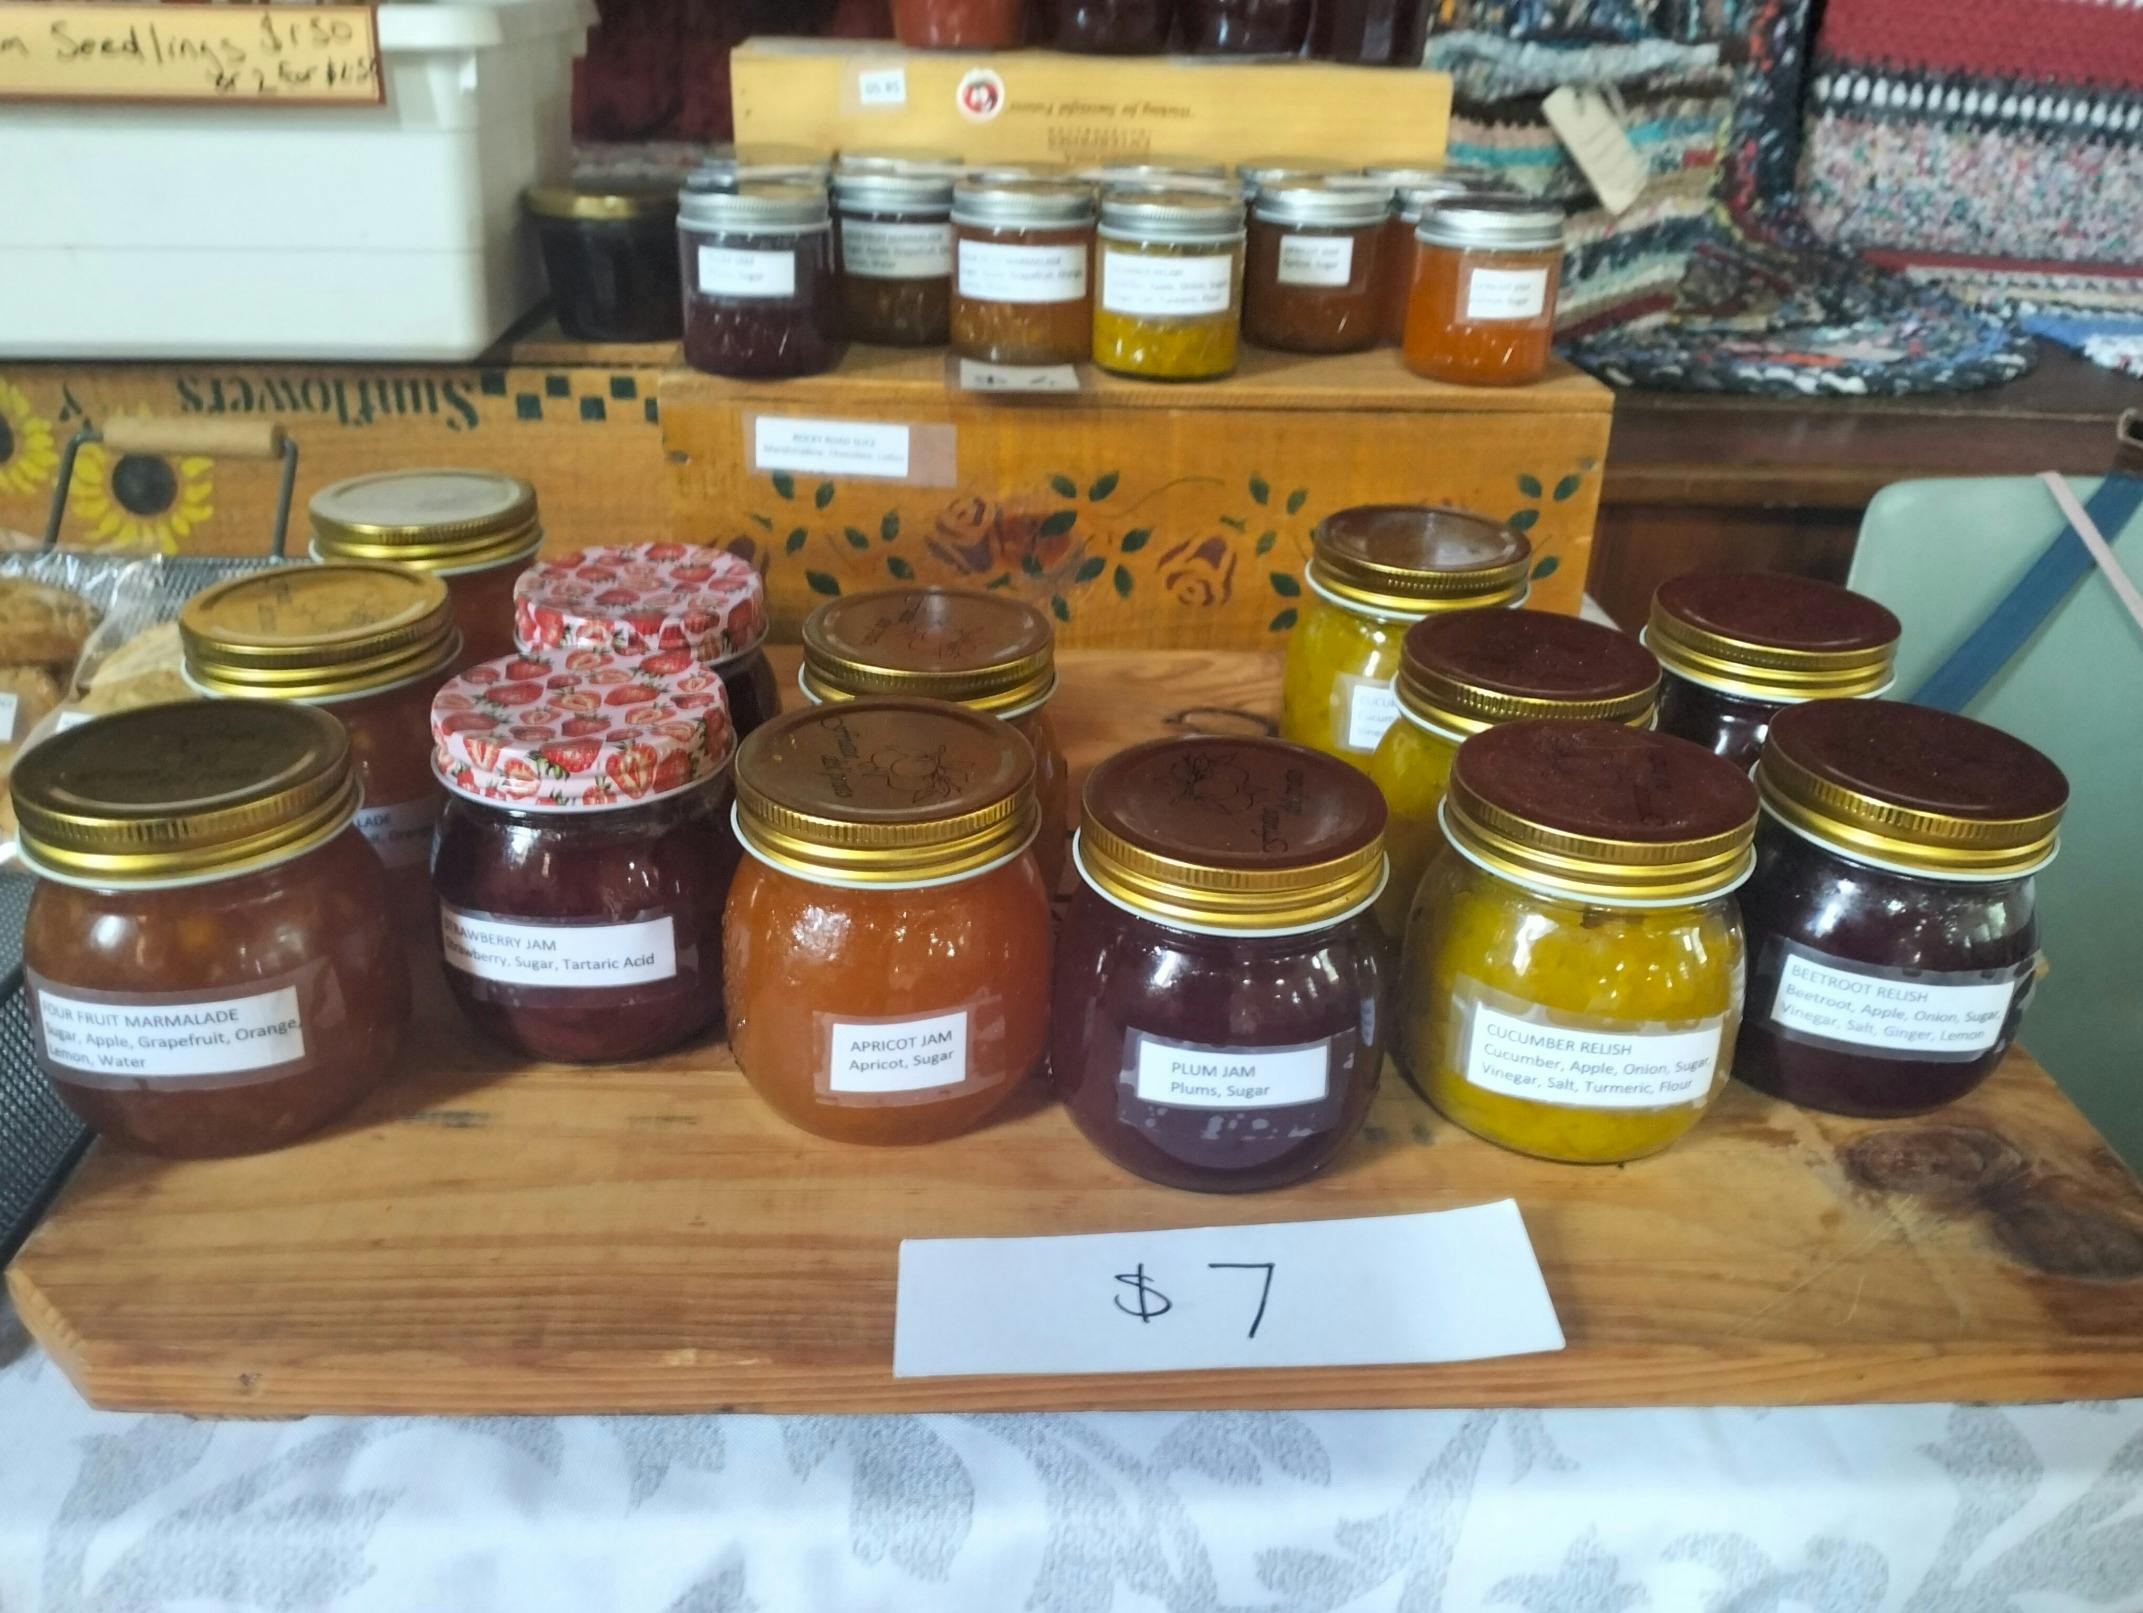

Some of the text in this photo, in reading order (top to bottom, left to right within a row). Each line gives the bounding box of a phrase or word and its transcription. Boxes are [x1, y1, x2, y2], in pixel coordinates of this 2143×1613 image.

[50, 20, 247, 72] Seedlings
[176, 375, 480, 432] Sunflowers
[525, 939, 557, 952] JAM
[514, 955, 559, 972] Sugar,
[563, 957, 619, 971] Tartaric
[623, 952, 655, 968] Acid
[1791, 964, 1929, 1003] BEETROOT RELISH
[1785, 983, 1856, 1013] Beetroot,
[1860, 1003, 1909, 1022] Apple,
[1914, 1009, 1961, 1024] Onion,
[77, 1010, 119, 1027] FRUIT
[124, 1008, 239, 1029] MARMALADE
[1780, 1002, 1985, 1043] Vinegar, Salt, Ginger, Lemon
[86, 1032, 135, 1050] Apple,
[138, 1032, 231, 1050] Grapefruit,
[850, 1030, 952, 1052] APRICOT JAM
[1486, 1023, 1633, 1056] CUCUMBER RELISH
[98, 1053, 147, 1069] Water
[849, 1050, 955, 1073] Apricot, Sugar
[1171, 1061, 1256, 1078] PLUM JAM
[1484, 1043, 1564, 1072] Cucumber,
[1569, 1059, 1618, 1077] Apple,
[1622, 1063, 1671, 1077] Onion,
[1170, 1081, 1271, 1099] Plums, Sugar
[1481, 1061, 1694, 1095] Vinegar, Salt, Turmeric, Flour
[1113, 1262, 1276, 1339] $ 7
